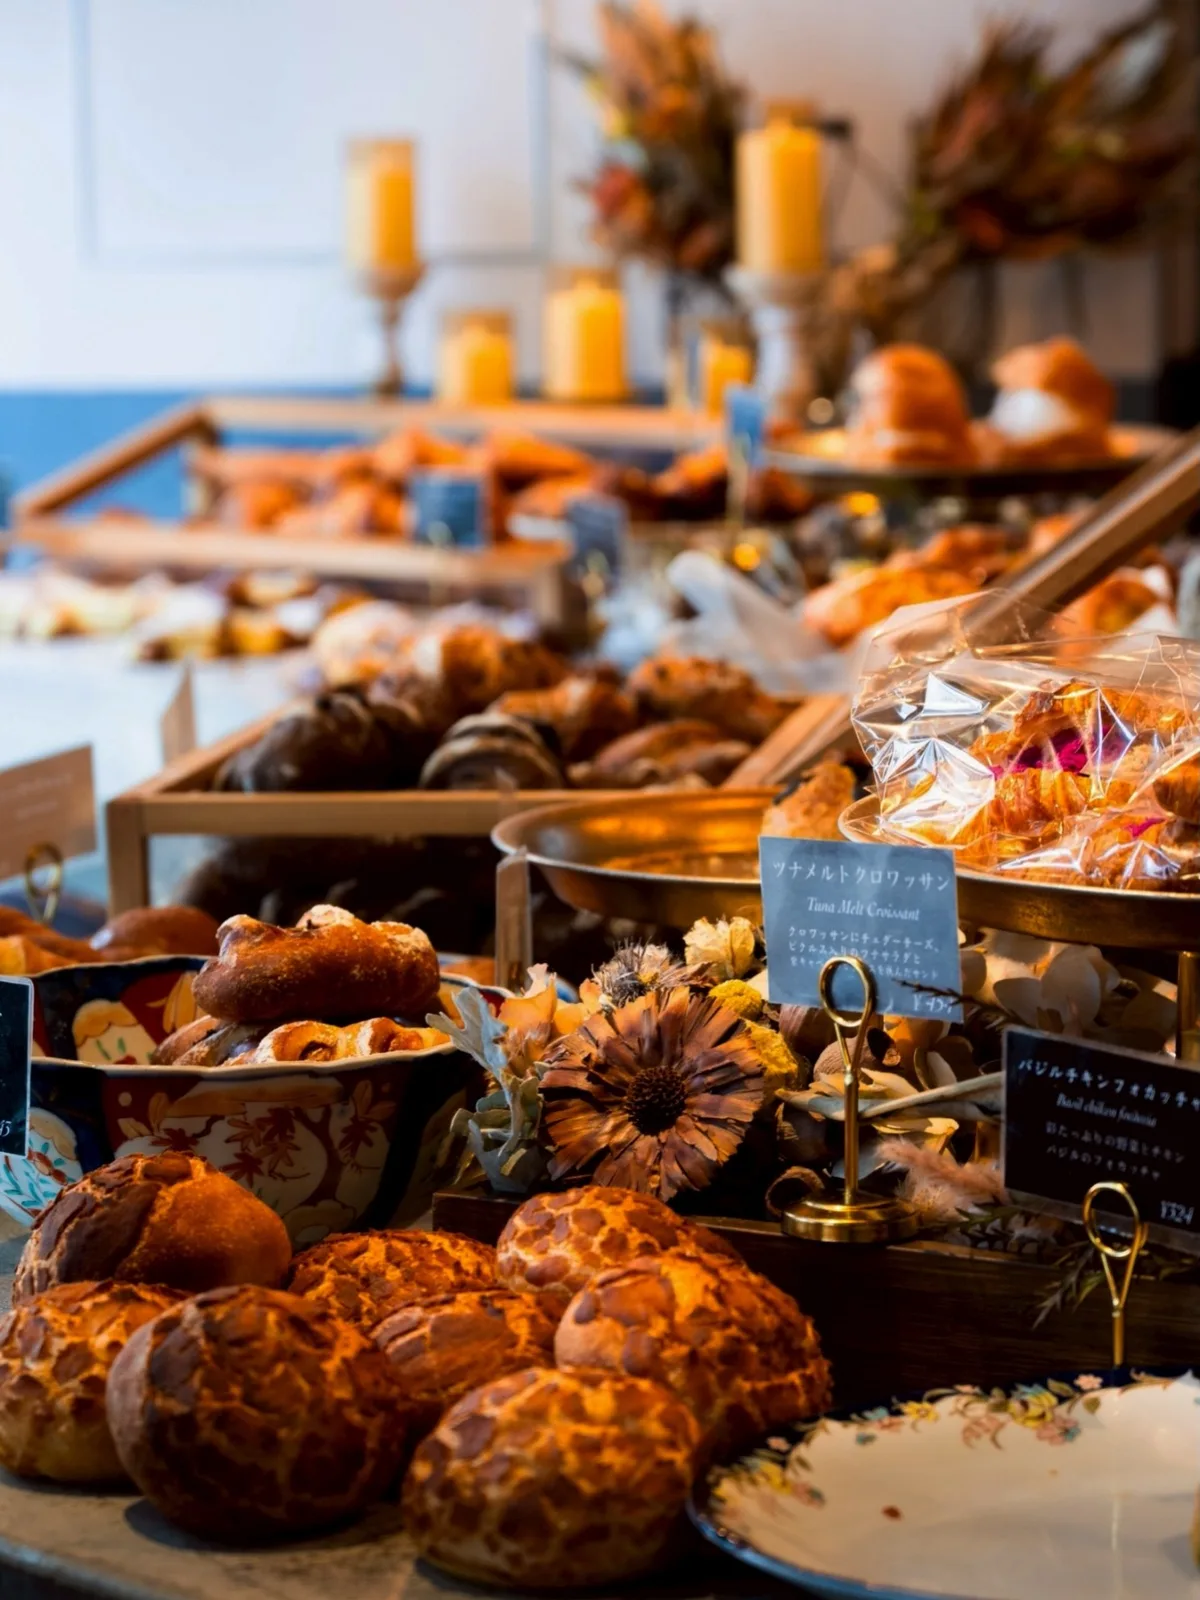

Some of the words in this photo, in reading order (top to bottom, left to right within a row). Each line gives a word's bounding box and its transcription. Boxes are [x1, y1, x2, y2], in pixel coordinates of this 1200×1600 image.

[772, 861, 950, 892] ツナメルトクロワッサン
[807, 896, 835, 914] Tuna
[837, 899, 863, 916] Melt
[867, 901, 920, 921] Croissant
